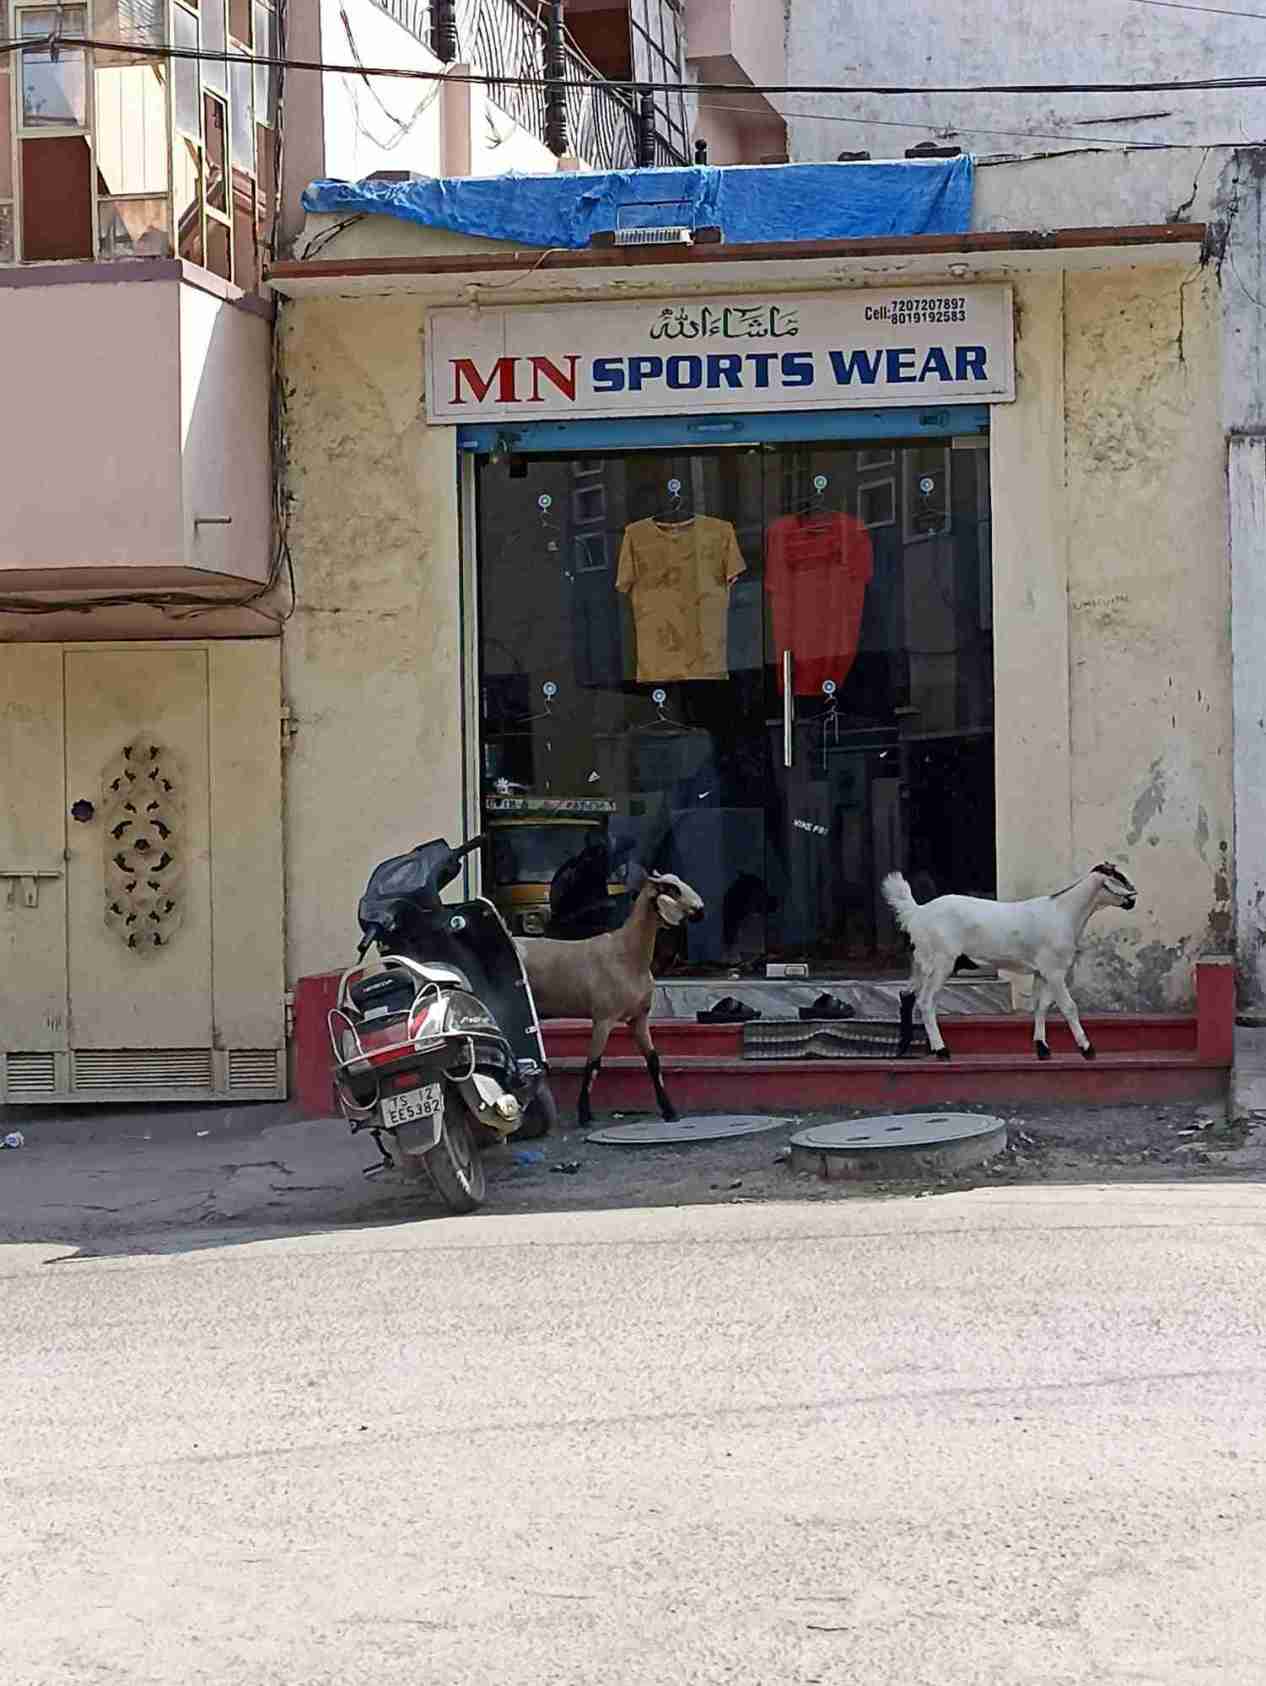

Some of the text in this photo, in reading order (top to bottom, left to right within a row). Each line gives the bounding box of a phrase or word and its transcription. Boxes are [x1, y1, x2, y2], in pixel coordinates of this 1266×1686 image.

[864, 298, 966, 321] Cell: 7207207897
[891, 311, 966, 325] 8019192583
[448, 346, 988, 404] MN SPORTS WEAR
[391, 1095, 409, 1108] TS
[391, 1099, 441, 1124] EE5382
